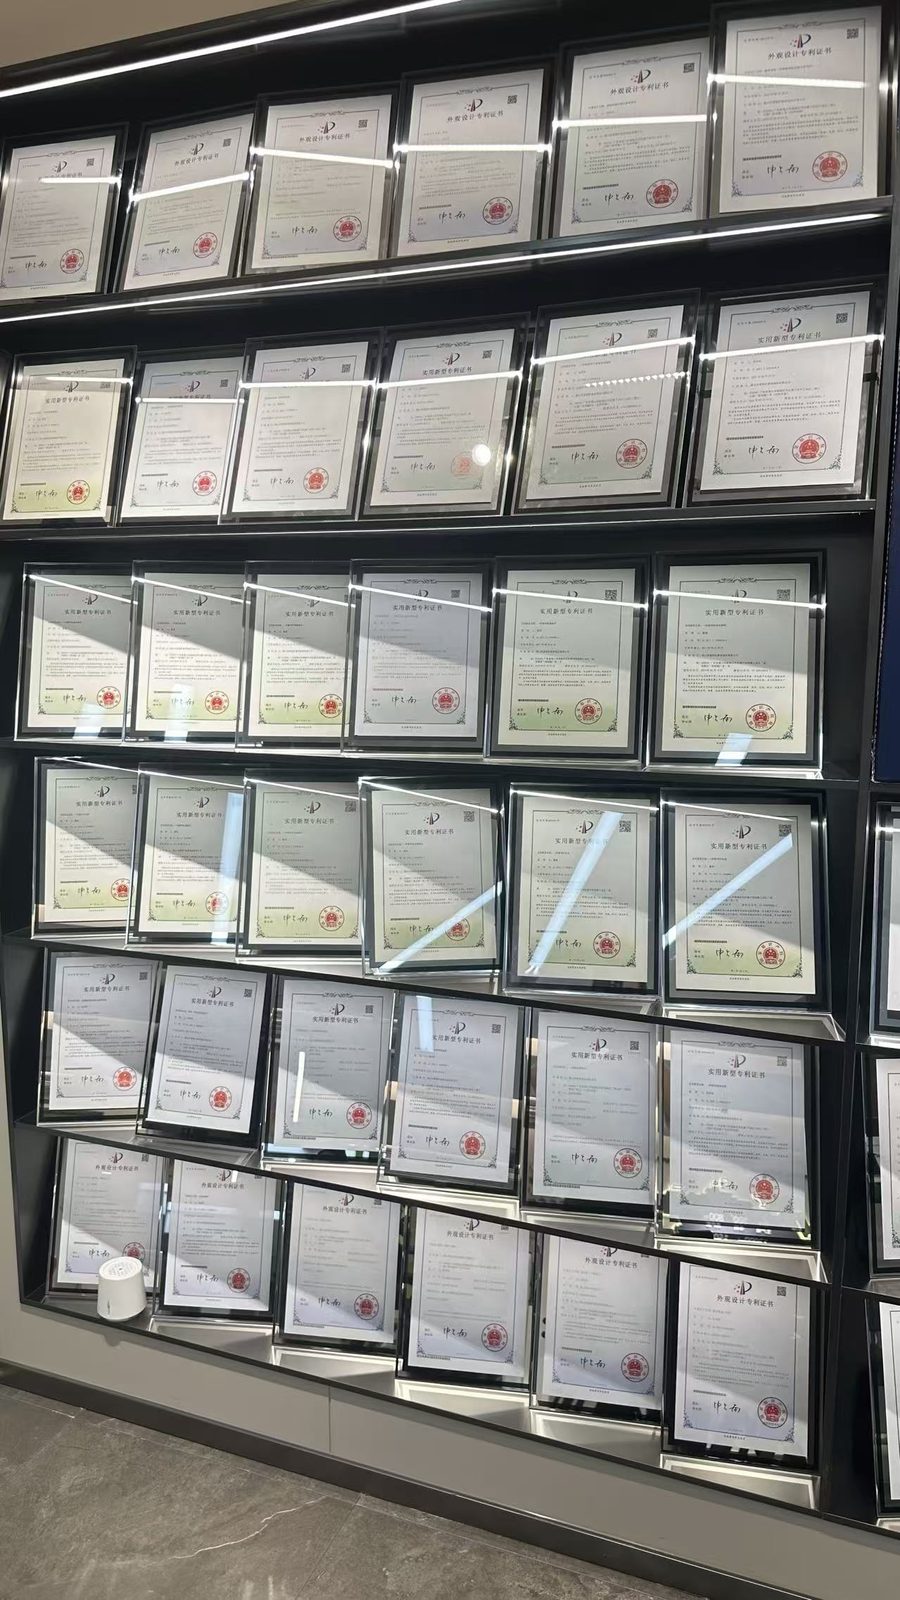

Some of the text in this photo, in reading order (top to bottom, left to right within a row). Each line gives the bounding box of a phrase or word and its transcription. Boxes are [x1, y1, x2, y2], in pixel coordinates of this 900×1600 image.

[767, 47, 832, 60] 外观设计专利证书
[609, 82, 669, 96] 外观设计专利证书
[447, 110, 504, 123] 外观设计专利证书
[299, 133, 351, 143] 外观设计专利证书
[757, 331, 822, 344] 实用新型专利证书
[422, 366, 473, 376] 实用新型专利证书
[45, 396, 90, 404] 实用新型专利证书
[191, 998, 234, 1007] 实用新型专利证书
[312, 1016, 359, 1024] 实用新型专利证书
[571, 1052, 623, 1061] 实用新型专利证书
[707, 1068, 766, 1079] 实用新型专利证书
[322, 1205, 367, 1215] 外观设计专利证书
[446, 1230, 494, 1240] 外观设计专利证书
[584, 1257, 638, 1269] 外观设计专利证书
[716, 1294, 774, 1308] 外观设计专利证书
